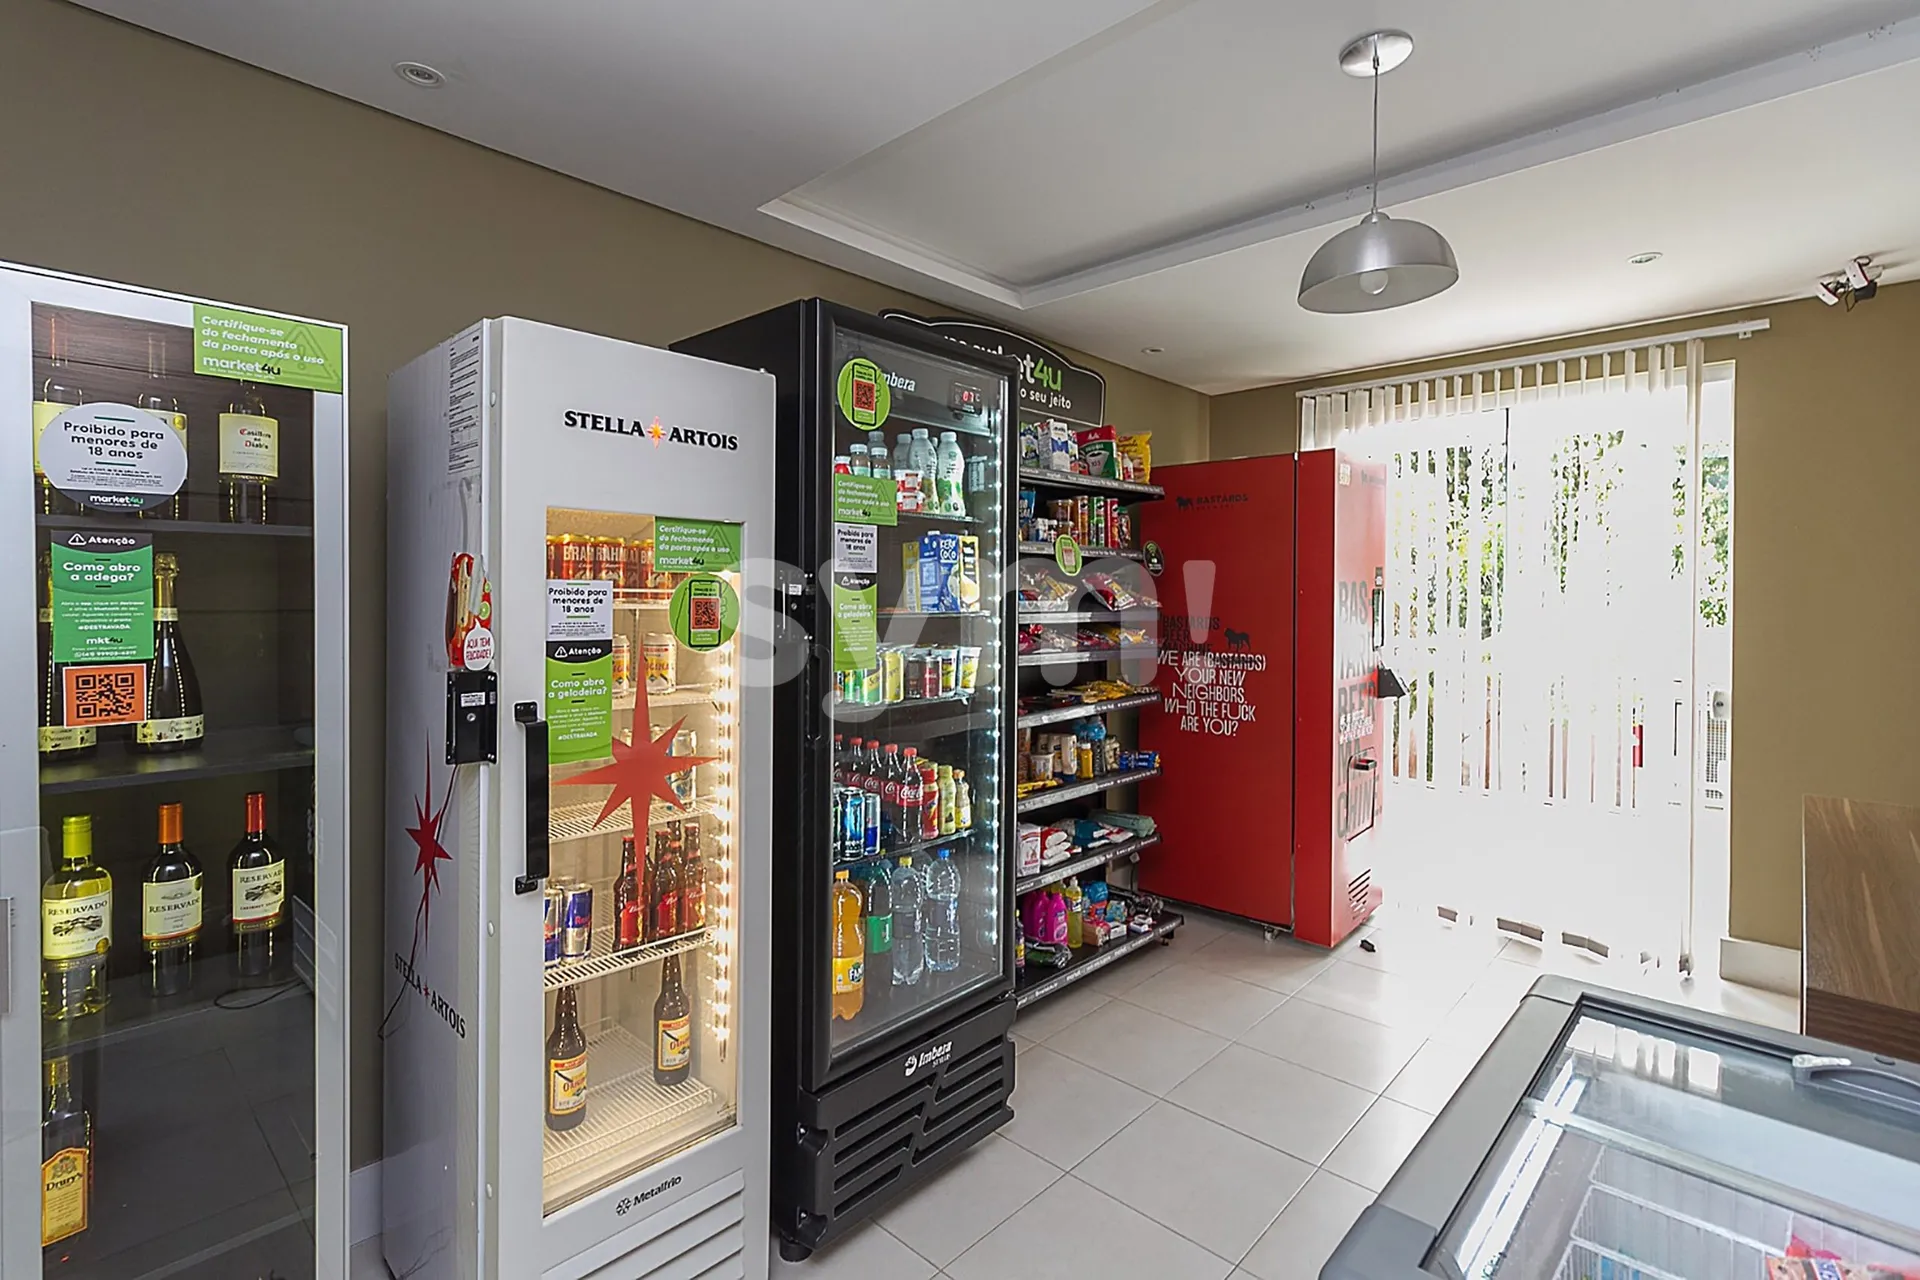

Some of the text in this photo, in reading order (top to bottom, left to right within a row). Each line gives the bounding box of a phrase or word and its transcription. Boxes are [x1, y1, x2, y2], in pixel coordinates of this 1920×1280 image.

[202, 316, 284, 337] Certifique-se
[202, 328, 298, 350] do fechamento
[202, 339, 219, 349] da
[222, 344, 258, 355] porta
[260, 348, 290, 361] após
[303, 356, 325, 365] uso
[203, 356, 281, 376] market4u
[883, 371, 916, 392] mbera
[1030, 389, 1047, 404] seu
[1049, 393, 1072, 410] jeito
[63, 421, 165, 441] Proibido para
[564, 409, 739, 451] STELLA ARTOIS
[71, 435, 158, 450] menores de
[88, 446, 144, 460] 18 anos
[90, 494, 144, 505] market4u
[659, 525, 707, 535] Certifique-se
[88, 535, 136, 547] Atenção
[63, 562, 141, 572] Como abro
[84, 573, 134, 583] adega?
[548, 587, 608, 597] Proibido para
[562, 605, 571, 613] 18
[568, 646, 602, 656] Atenção
[1157, 650, 1178, 666] WE
[1182, 650, 1200, 668] ARE
[551, 678, 605, 688] Como abro
[1174, 666, 1246, 686] YOUR NEW
[557, 687, 608, 699] geladeira?
[1164, 698, 1197, 716] WHO
[1200, 701, 1219, 718] THE
[1221, 703, 1257, 722] FUCK
[1180, 715, 1239, 737] ARE YOU?
[48, 900, 108, 916] RESERVADO
[430, 989, 466, 1039] ARTOIS
[633, 1175, 682, 1206] Metalfrio
